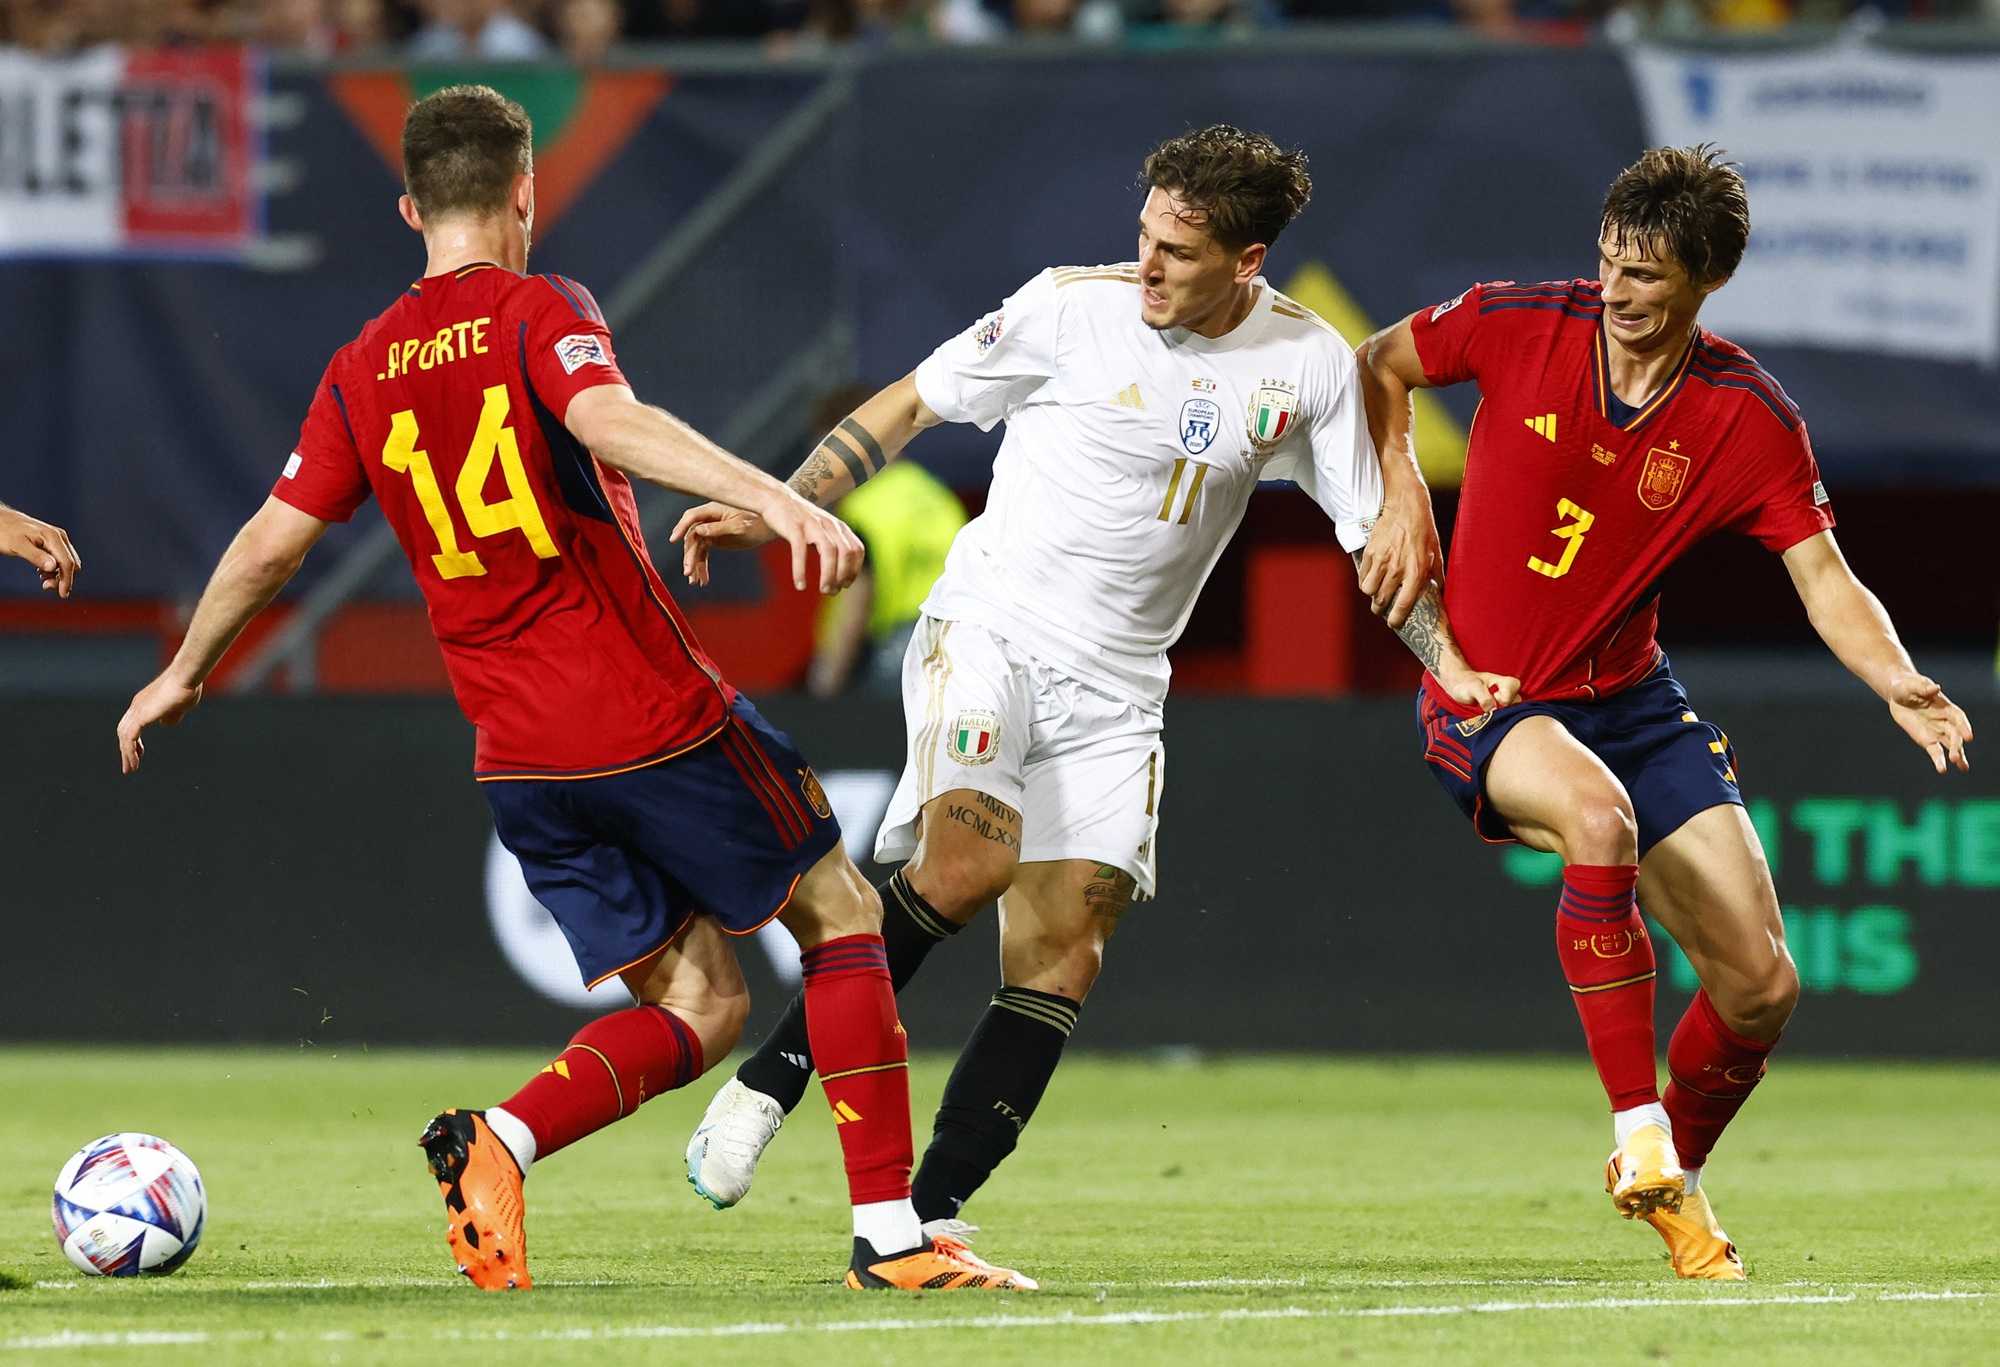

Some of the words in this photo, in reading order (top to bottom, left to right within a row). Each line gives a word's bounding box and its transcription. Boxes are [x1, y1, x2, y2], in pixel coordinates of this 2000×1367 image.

[377, 317, 491, 381] APORTE
[1188, 408, 1215, 416] EUROPEAN
[382, 383, 560, 580] 14
[1157, 458, 1210, 525] 11
[1527, 497, 1595, 579] 3
[960, 718, 992, 728] ITALIA
[977, 792, 1015, 823] MMIV
